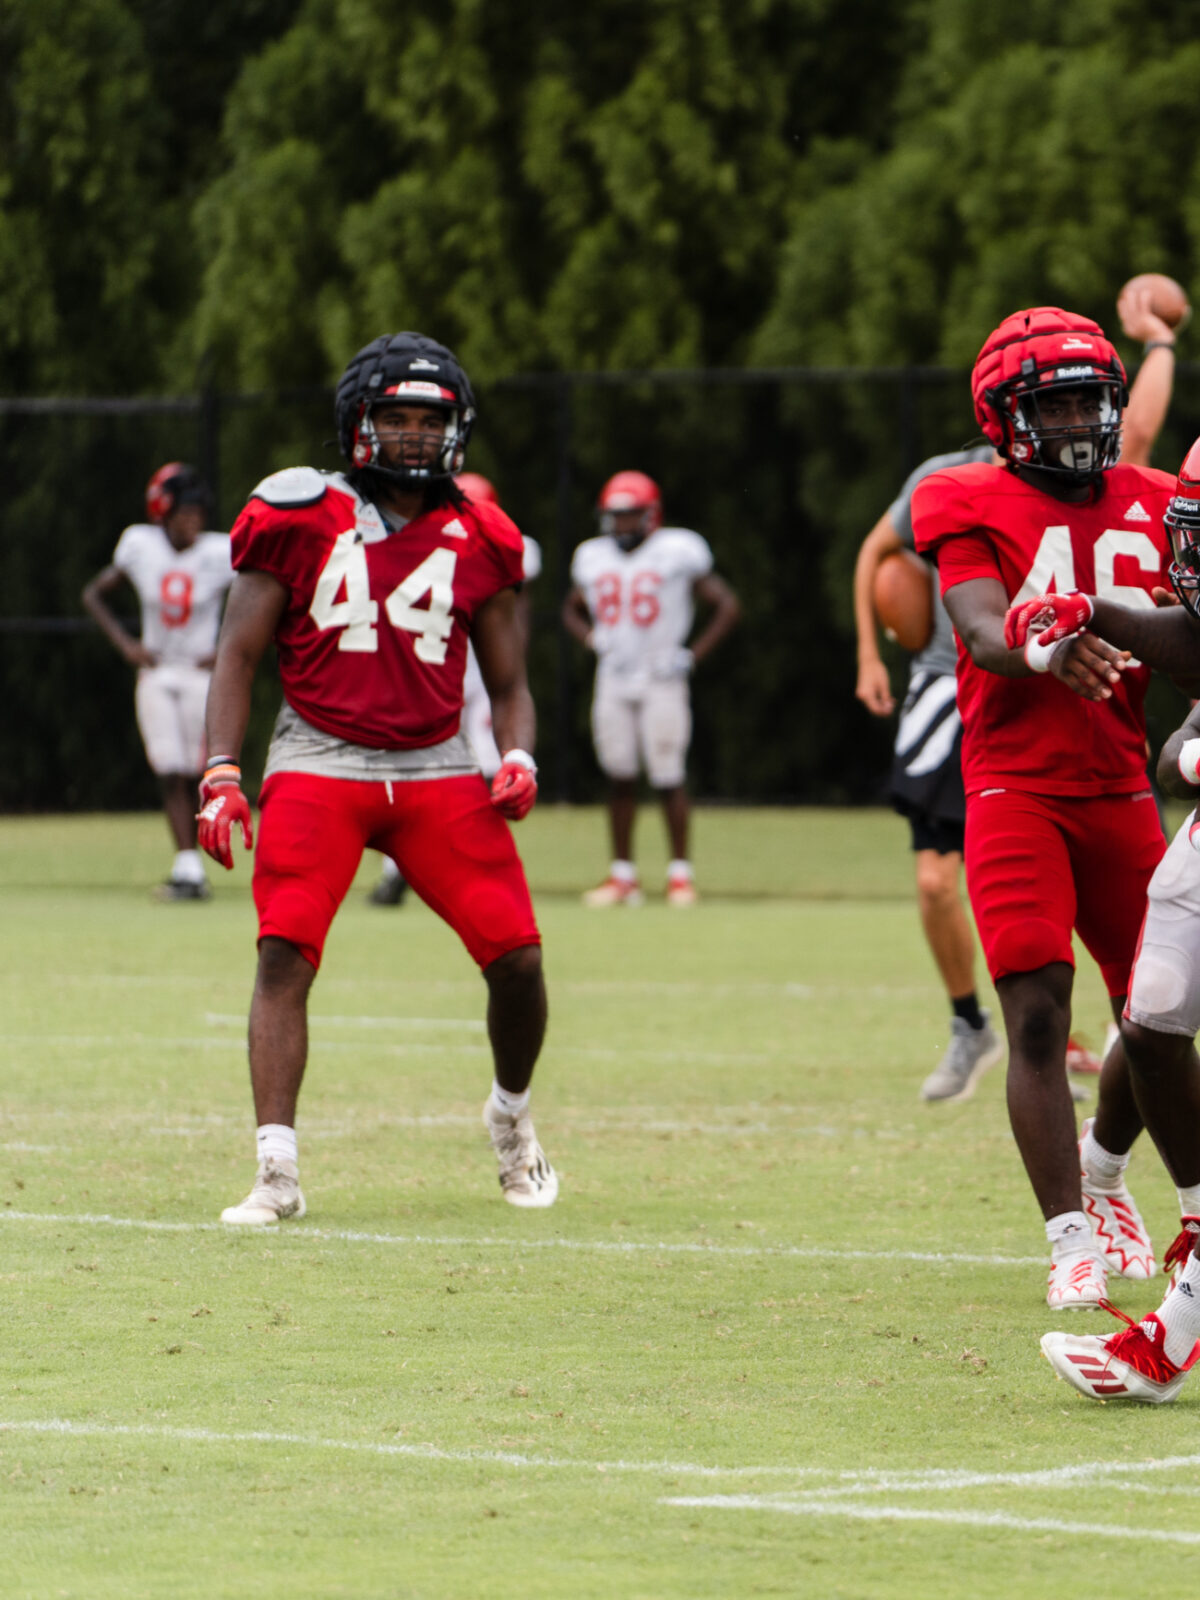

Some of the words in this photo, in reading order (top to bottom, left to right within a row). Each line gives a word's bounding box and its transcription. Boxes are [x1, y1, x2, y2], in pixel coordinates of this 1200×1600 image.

[161, 570, 194, 630] 9
[308, 527, 458, 667] 44
[594, 571, 664, 628] 86
[1010, 525, 1160, 664] 46
